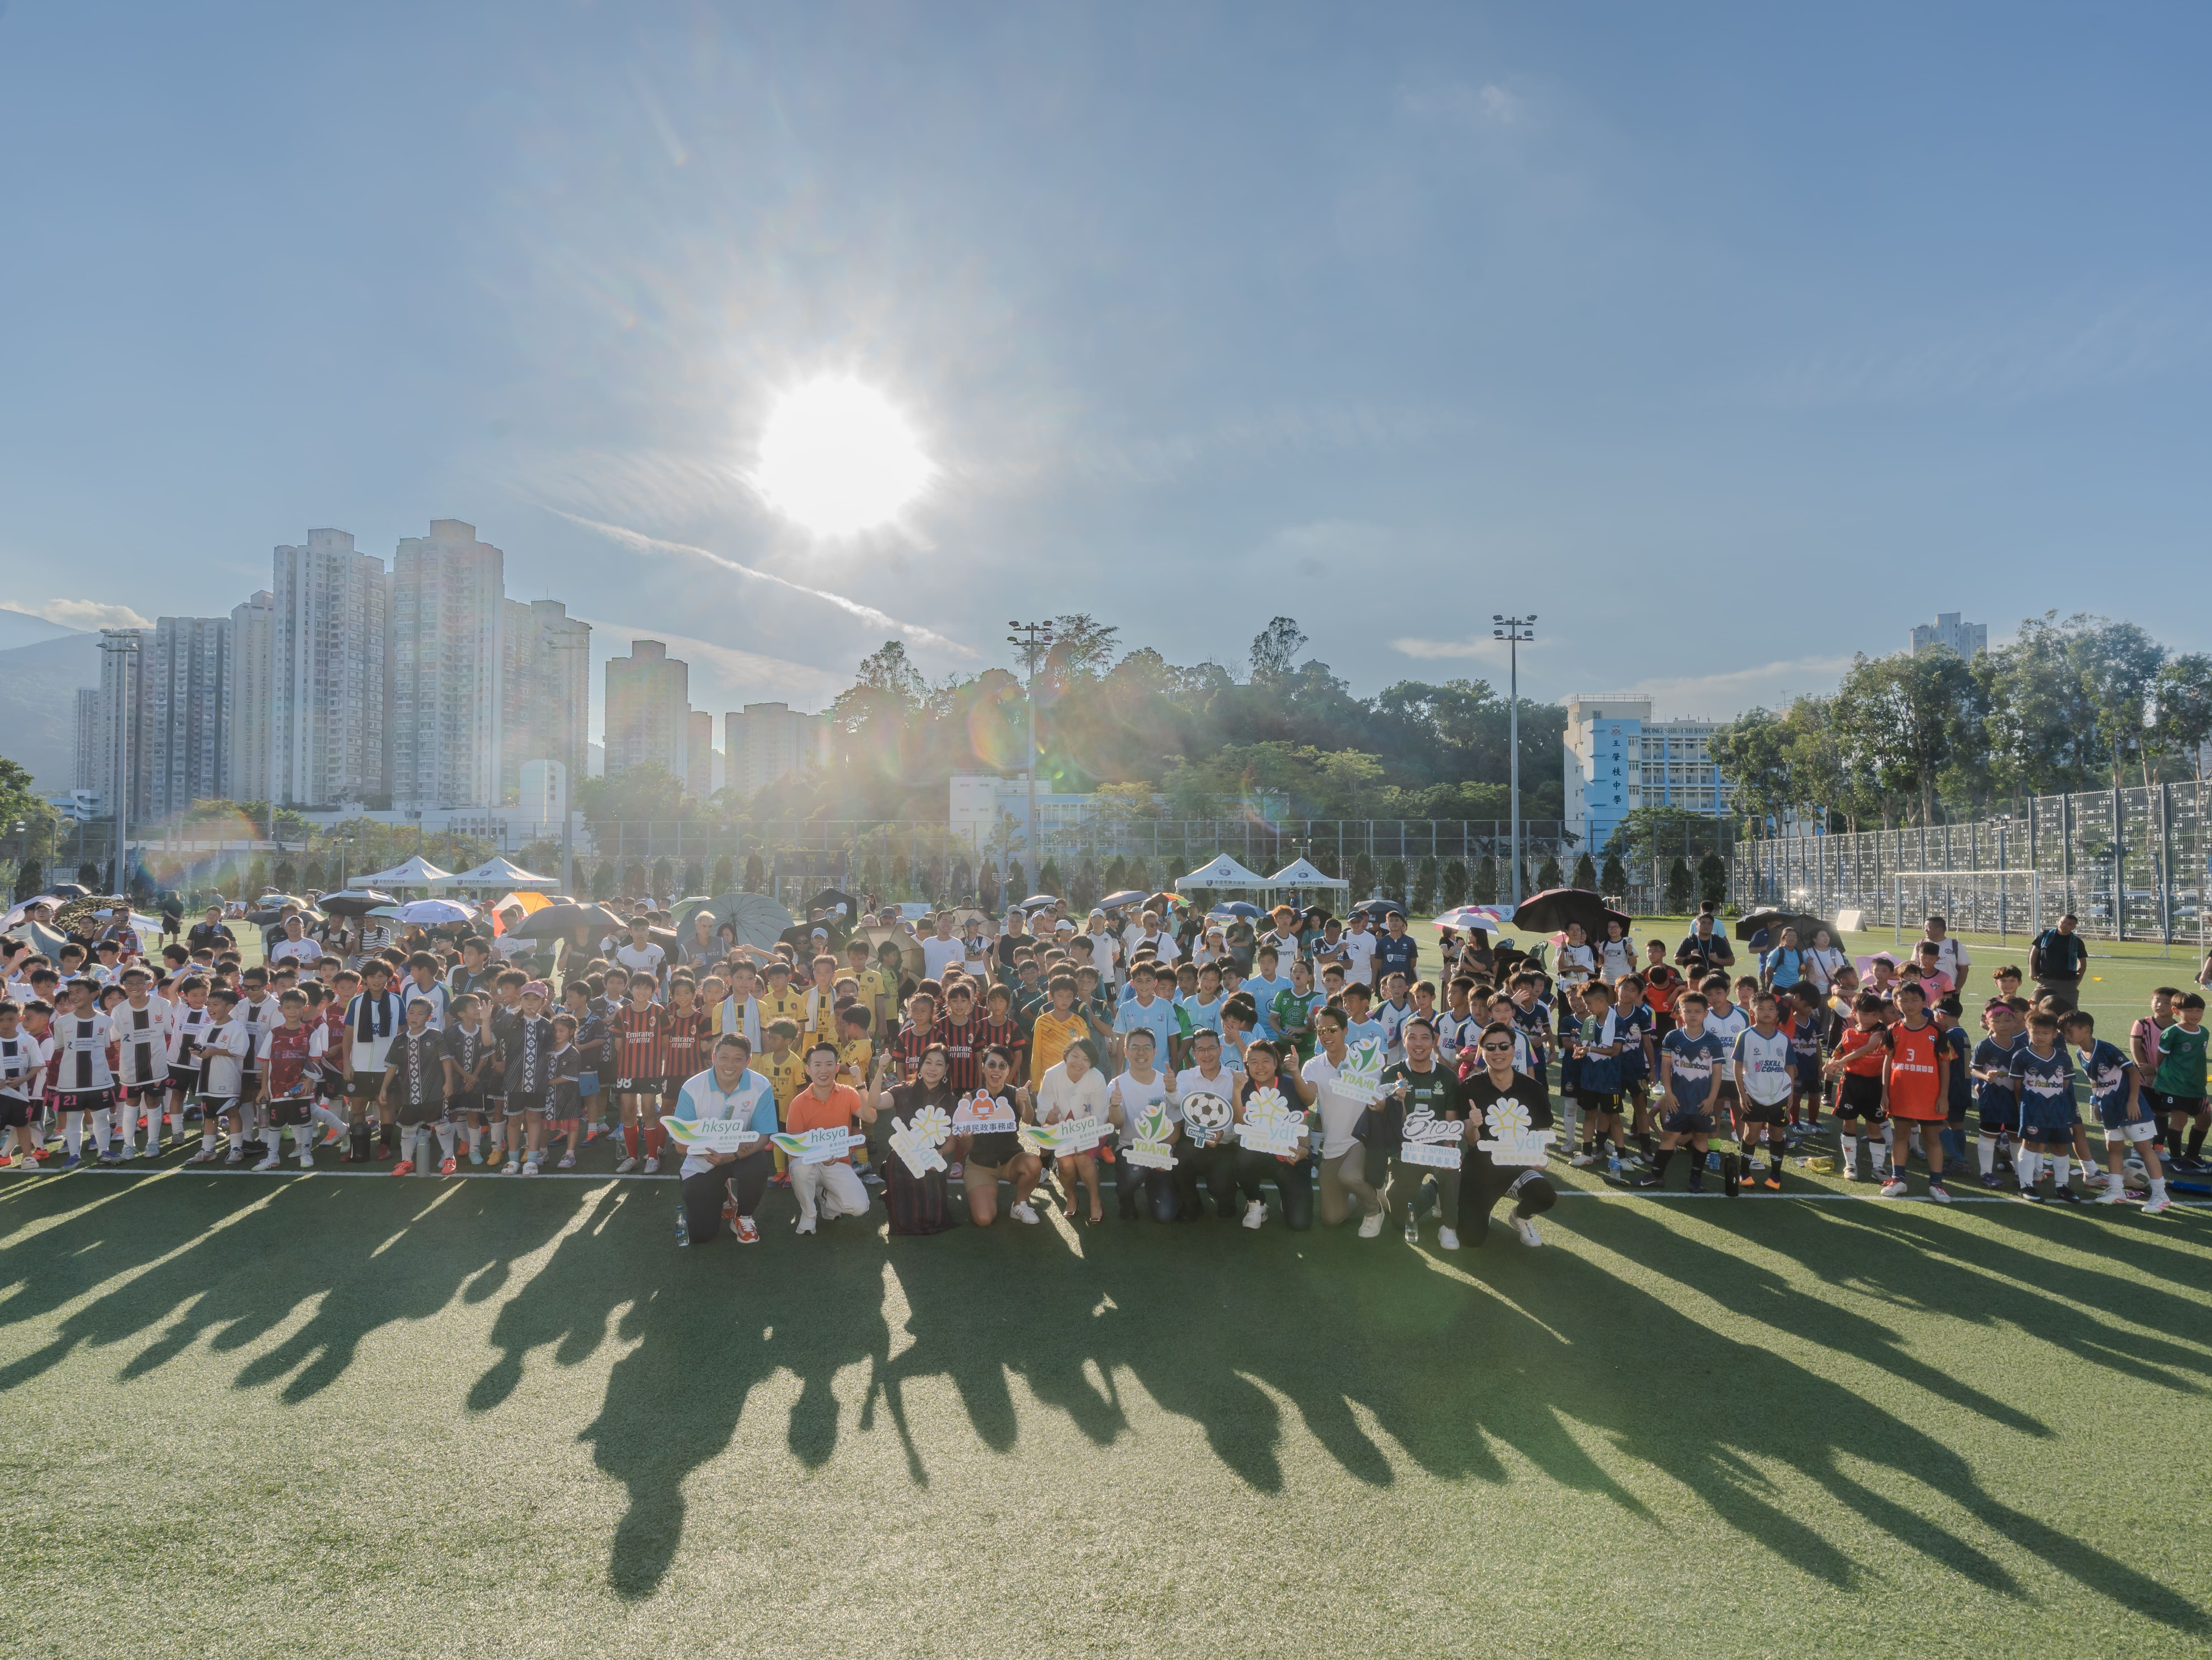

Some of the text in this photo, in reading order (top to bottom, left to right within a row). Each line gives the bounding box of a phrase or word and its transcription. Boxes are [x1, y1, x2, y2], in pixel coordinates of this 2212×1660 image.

[1611, 740, 1622, 804] 王肇枝中學
[1110, 986, 1116, 995] 18
[1906, 1048, 1915, 1062] 3
[63, 1095, 77, 1106] 21
[1613, 1094, 1619, 1104] 11
[1782, 1106, 1787, 1117] 7
[701, 1120, 740, 1134] hksya
[954, 1122, 1015, 1133] 大埔民政事務處
[1062, 1119, 1095, 1136] hksya
[1404, 1112, 1462, 1137] 5100
[811, 1128, 846, 1143] hksya
[1189, 1130, 1204, 1138] CHING
[1269, 1125, 1297, 1141] ydf
[1514, 1134, 1543, 1152] ydf
[911, 1142, 939, 1166] ydf
[1404, 1144, 1459, 1157] TIBET SPRING
